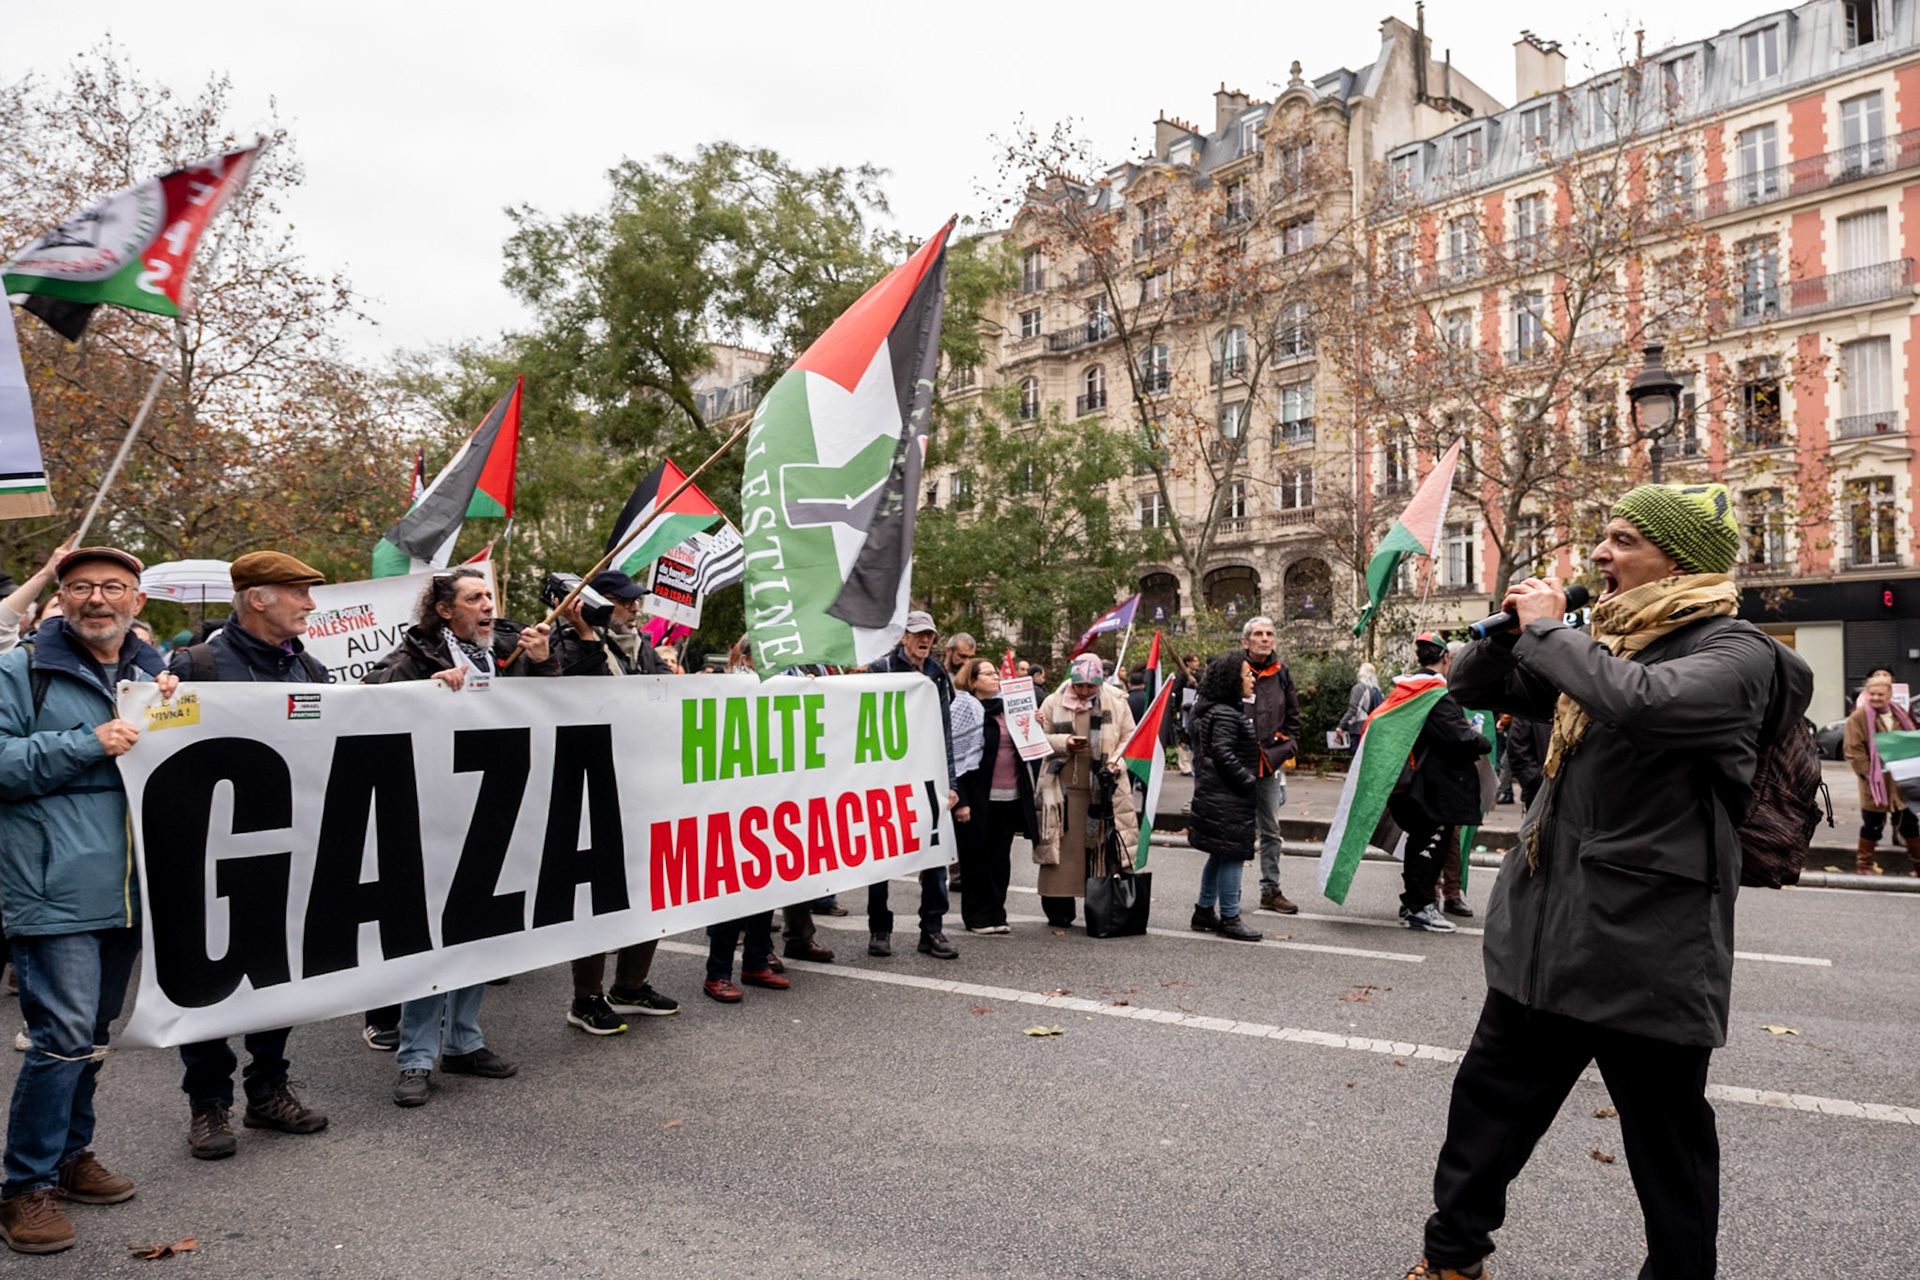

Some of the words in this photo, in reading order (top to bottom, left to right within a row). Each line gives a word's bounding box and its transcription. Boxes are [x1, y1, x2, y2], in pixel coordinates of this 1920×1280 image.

[655, 584, 669, 598] PAR
[306, 611, 339, 625] JUSTICE
[339, 607, 361, 619] POUR
[307, 612, 378, 639] PALESTINE
[682, 694, 826, 783] HALTE
[855, 690, 908, 764] AU
[142, 724, 630, 1009] GAZA
